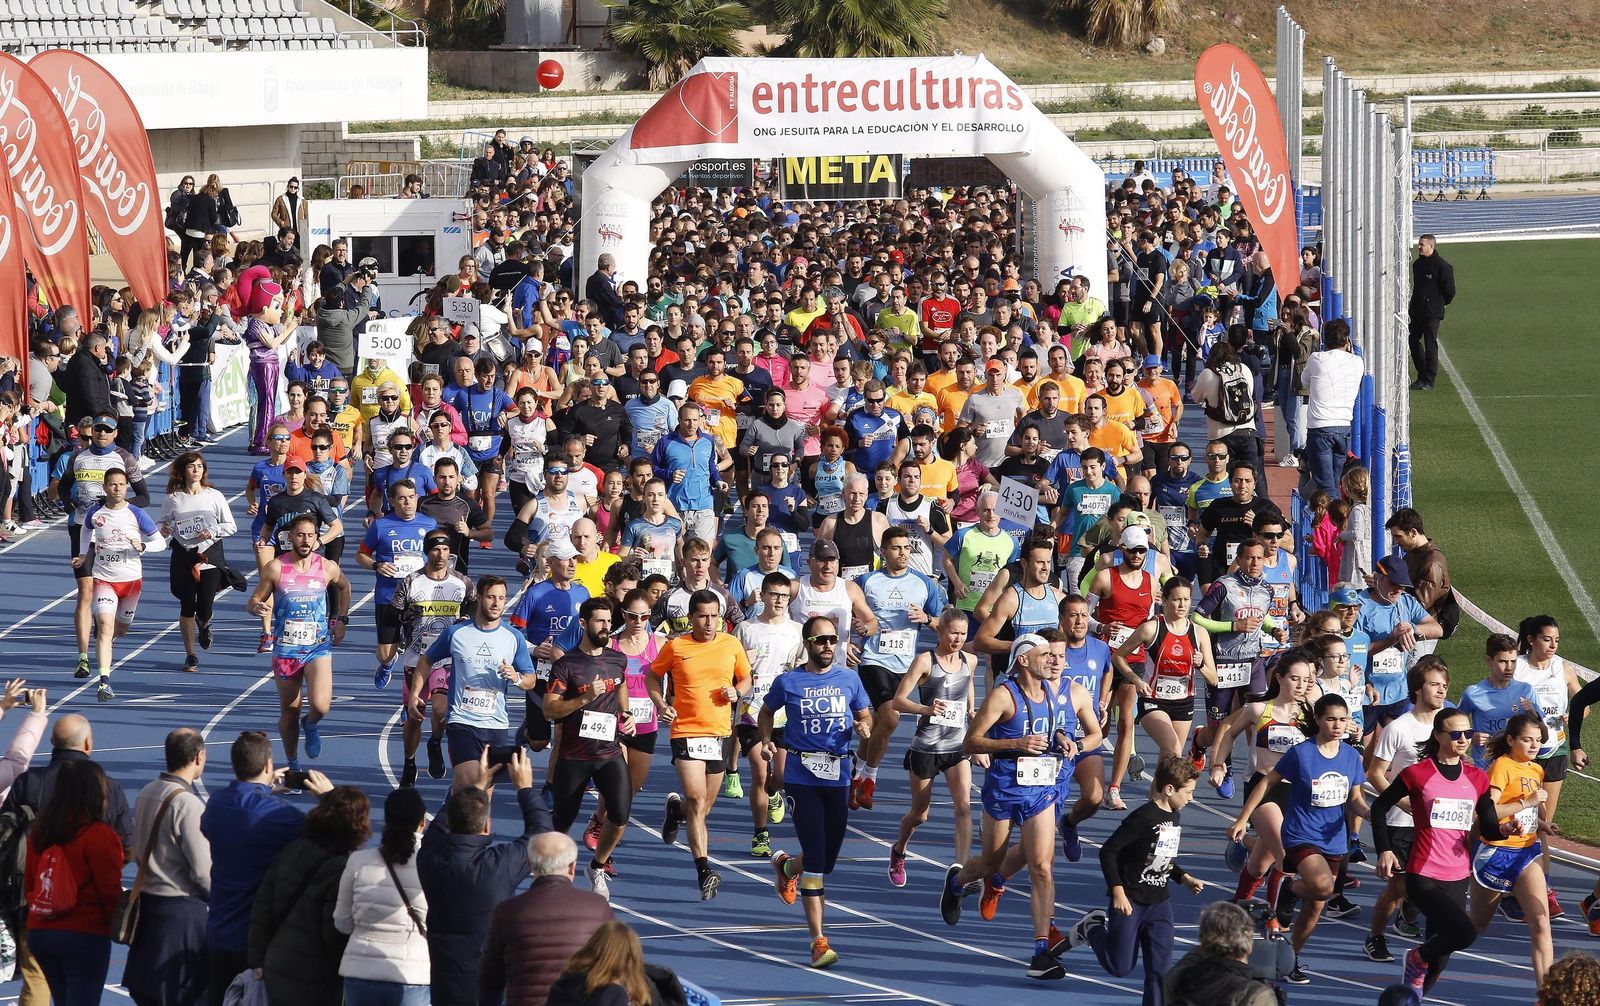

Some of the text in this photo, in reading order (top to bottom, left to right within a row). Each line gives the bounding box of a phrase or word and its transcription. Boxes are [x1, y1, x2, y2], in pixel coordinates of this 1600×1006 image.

[752, 67, 1023, 115] entreculturas
[753, 121, 1025, 137] ONG JESUITA PARA LA EDUCACIÓN Y EL DESARROLLO
[1210, 62, 1287, 225] Coca-Cola
[786, 155, 896, 184] META
[452, 301, 474, 312] 5:30
[371, 337, 401, 349] 5:00
[1001, 486, 1033, 511] 4:30
[1088, 502, 1105, 510] 4073
[1003, 508, 1027, 521] min/km
[106, 554, 120, 562] 362
[292, 631, 308, 639] 419
[889, 639, 904, 648] 118
[1382, 657, 1398, 667] 450
[1226, 673, 1242, 682] 411
[803, 685, 841, 698] Triatlón
[1166, 685, 1182, 694] 288
[468, 696, 490, 708] 4082
[800, 695, 846, 714] RCM
[941, 710, 957, 720] 428
[590, 722, 607, 734] 496
[801, 717, 846, 734] 1873
[696, 742, 712, 753] 416
[811, 762, 830, 773] 292
[1033, 768, 1039, 778] 8
[1319, 788, 1342, 801] 4211
[1439, 810, 1464, 821] 4108
